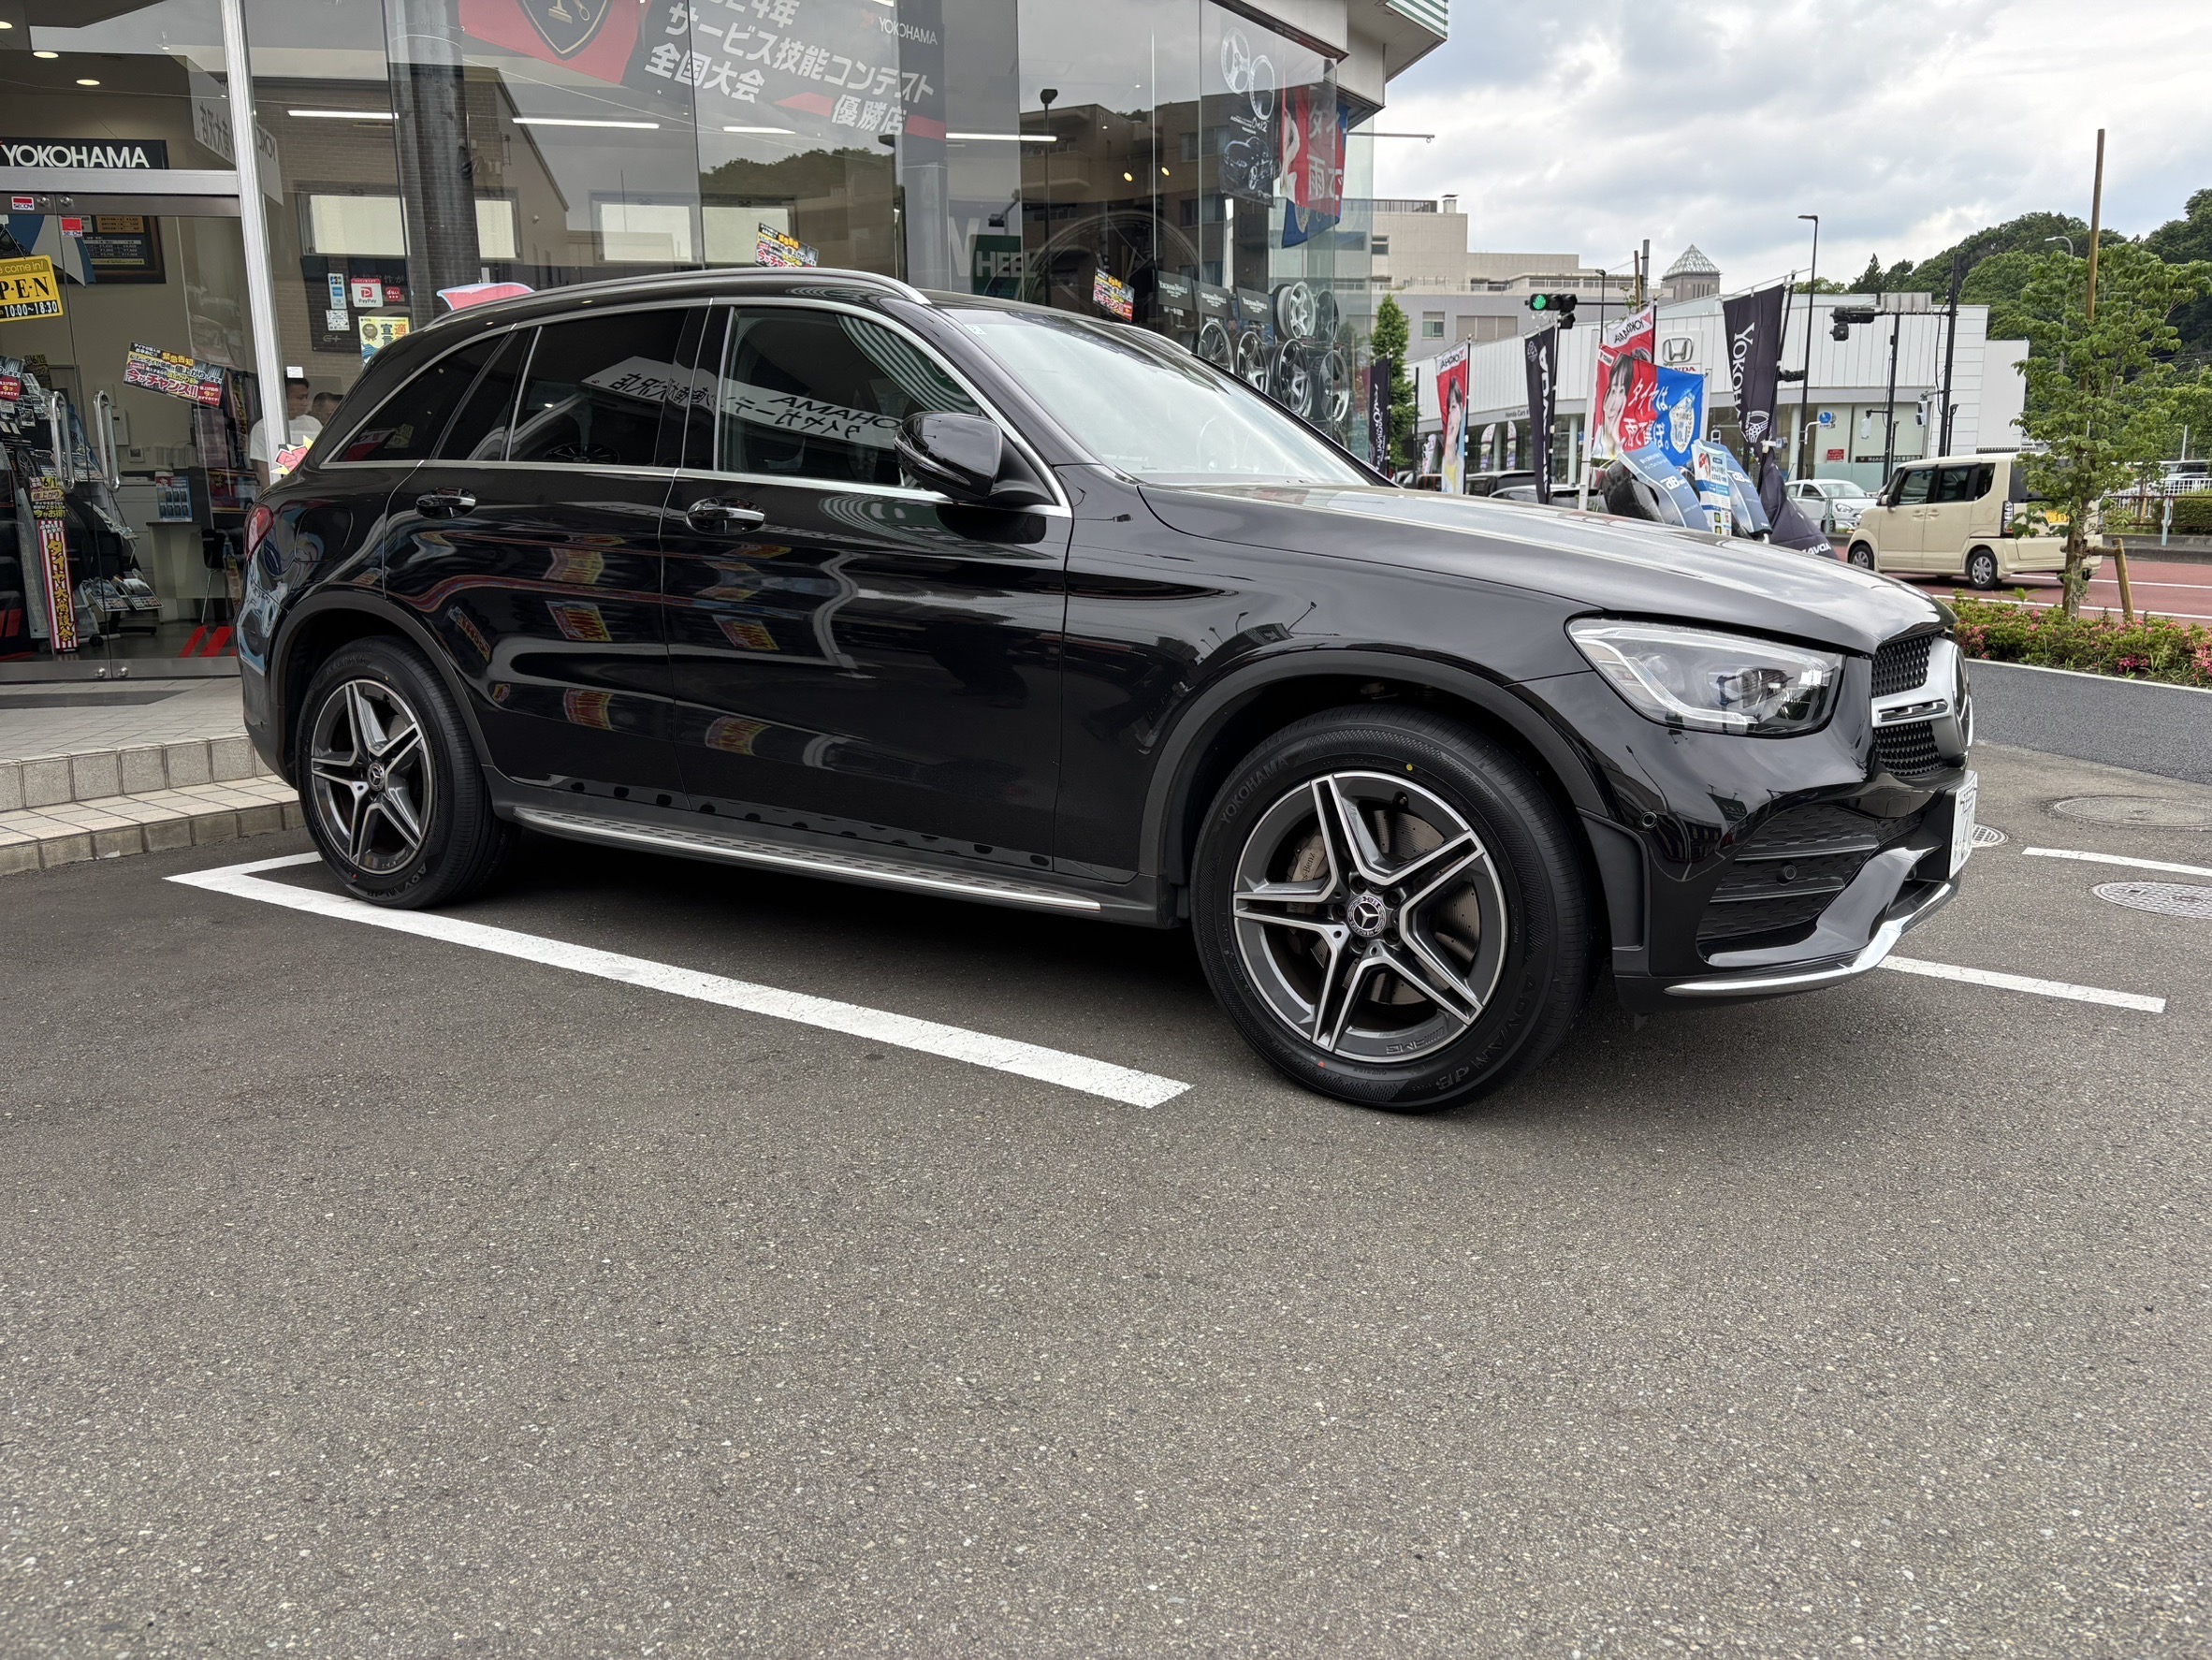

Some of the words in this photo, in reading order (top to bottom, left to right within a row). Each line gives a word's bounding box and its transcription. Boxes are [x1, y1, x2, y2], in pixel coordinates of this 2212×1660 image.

[879, 16, 938, 45] YOKOHAMA
[644, 42, 765, 103] 全国大会
[664, 3, 934, 104] サービス技能コンテスト
[831, 94, 908, 136] 優勝店
[1, 144, 151, 168] YOKOHAMA
[4, 264, 32, 273] come
[1220, 755, 1288, 824] YOKOHAMA
